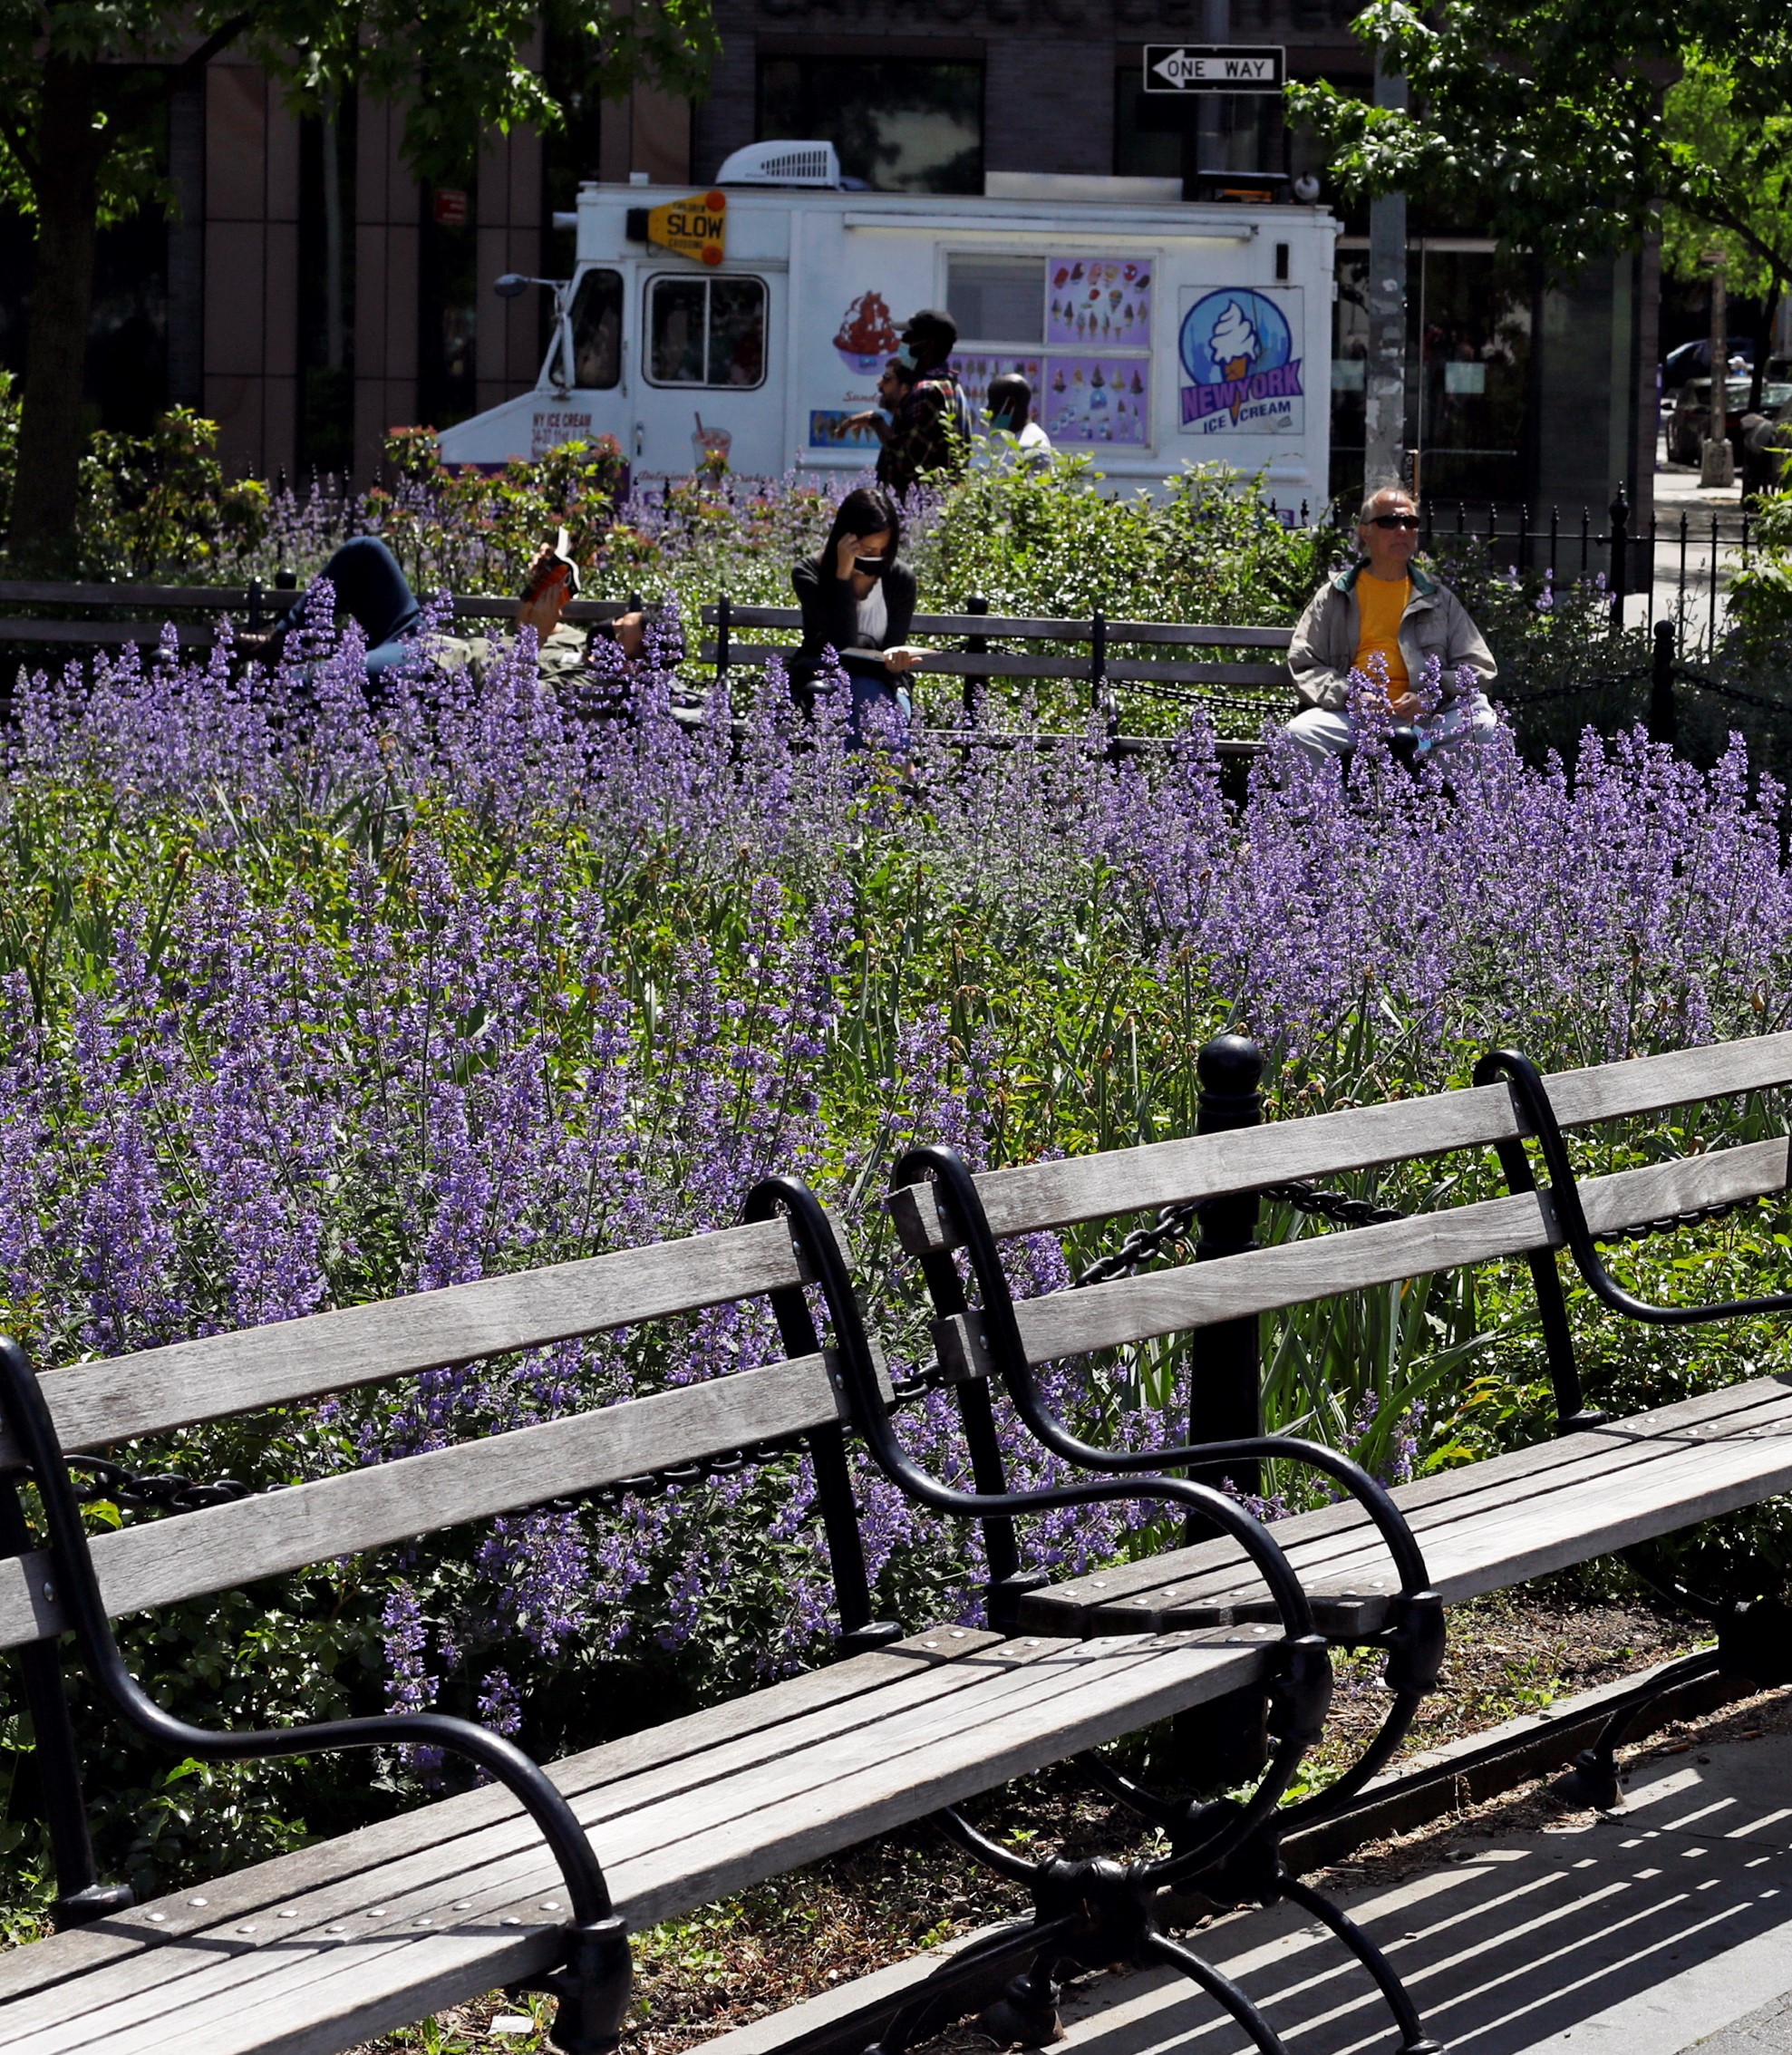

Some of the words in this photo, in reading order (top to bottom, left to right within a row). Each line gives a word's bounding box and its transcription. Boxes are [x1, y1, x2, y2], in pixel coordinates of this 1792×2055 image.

[1167, 60, 1206, 78] ONE
[1225, 61, 1265, 78] WAY
[667, 214, 723, 239] SLOW
[547, 412, 561, 427] ICE
[562, 412, 592, 428] CREAM
[1203, 414, 1226, 434] ICE
[1239, 401, 1292, 422] CREAM
